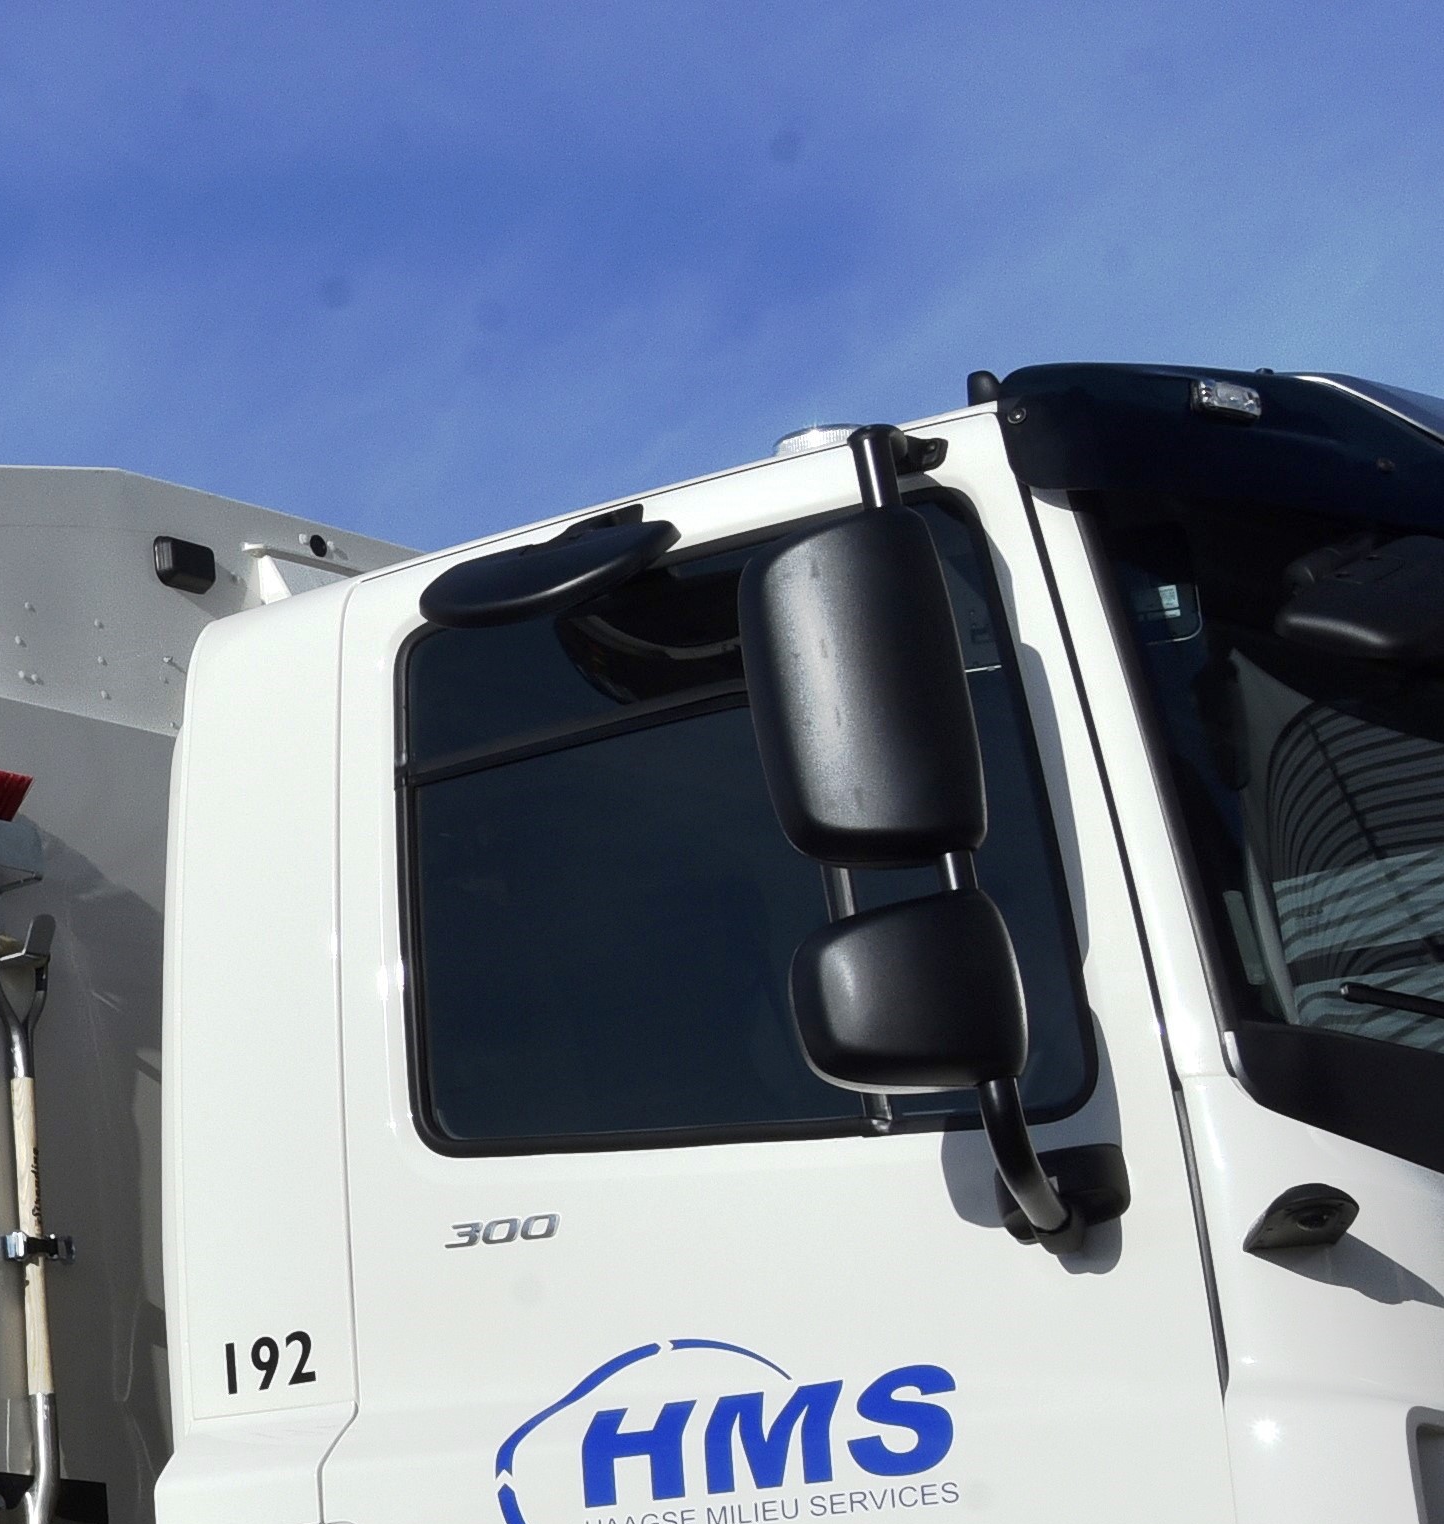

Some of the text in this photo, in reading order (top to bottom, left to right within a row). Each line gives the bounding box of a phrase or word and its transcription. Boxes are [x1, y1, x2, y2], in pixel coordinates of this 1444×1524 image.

[444, 1213, 560, 1249] 300
[225, 1330, 317, 1395] 192
[581, 1364, 957, 1509] HMS
[809, 1481, 960, 1517] SERVICES
